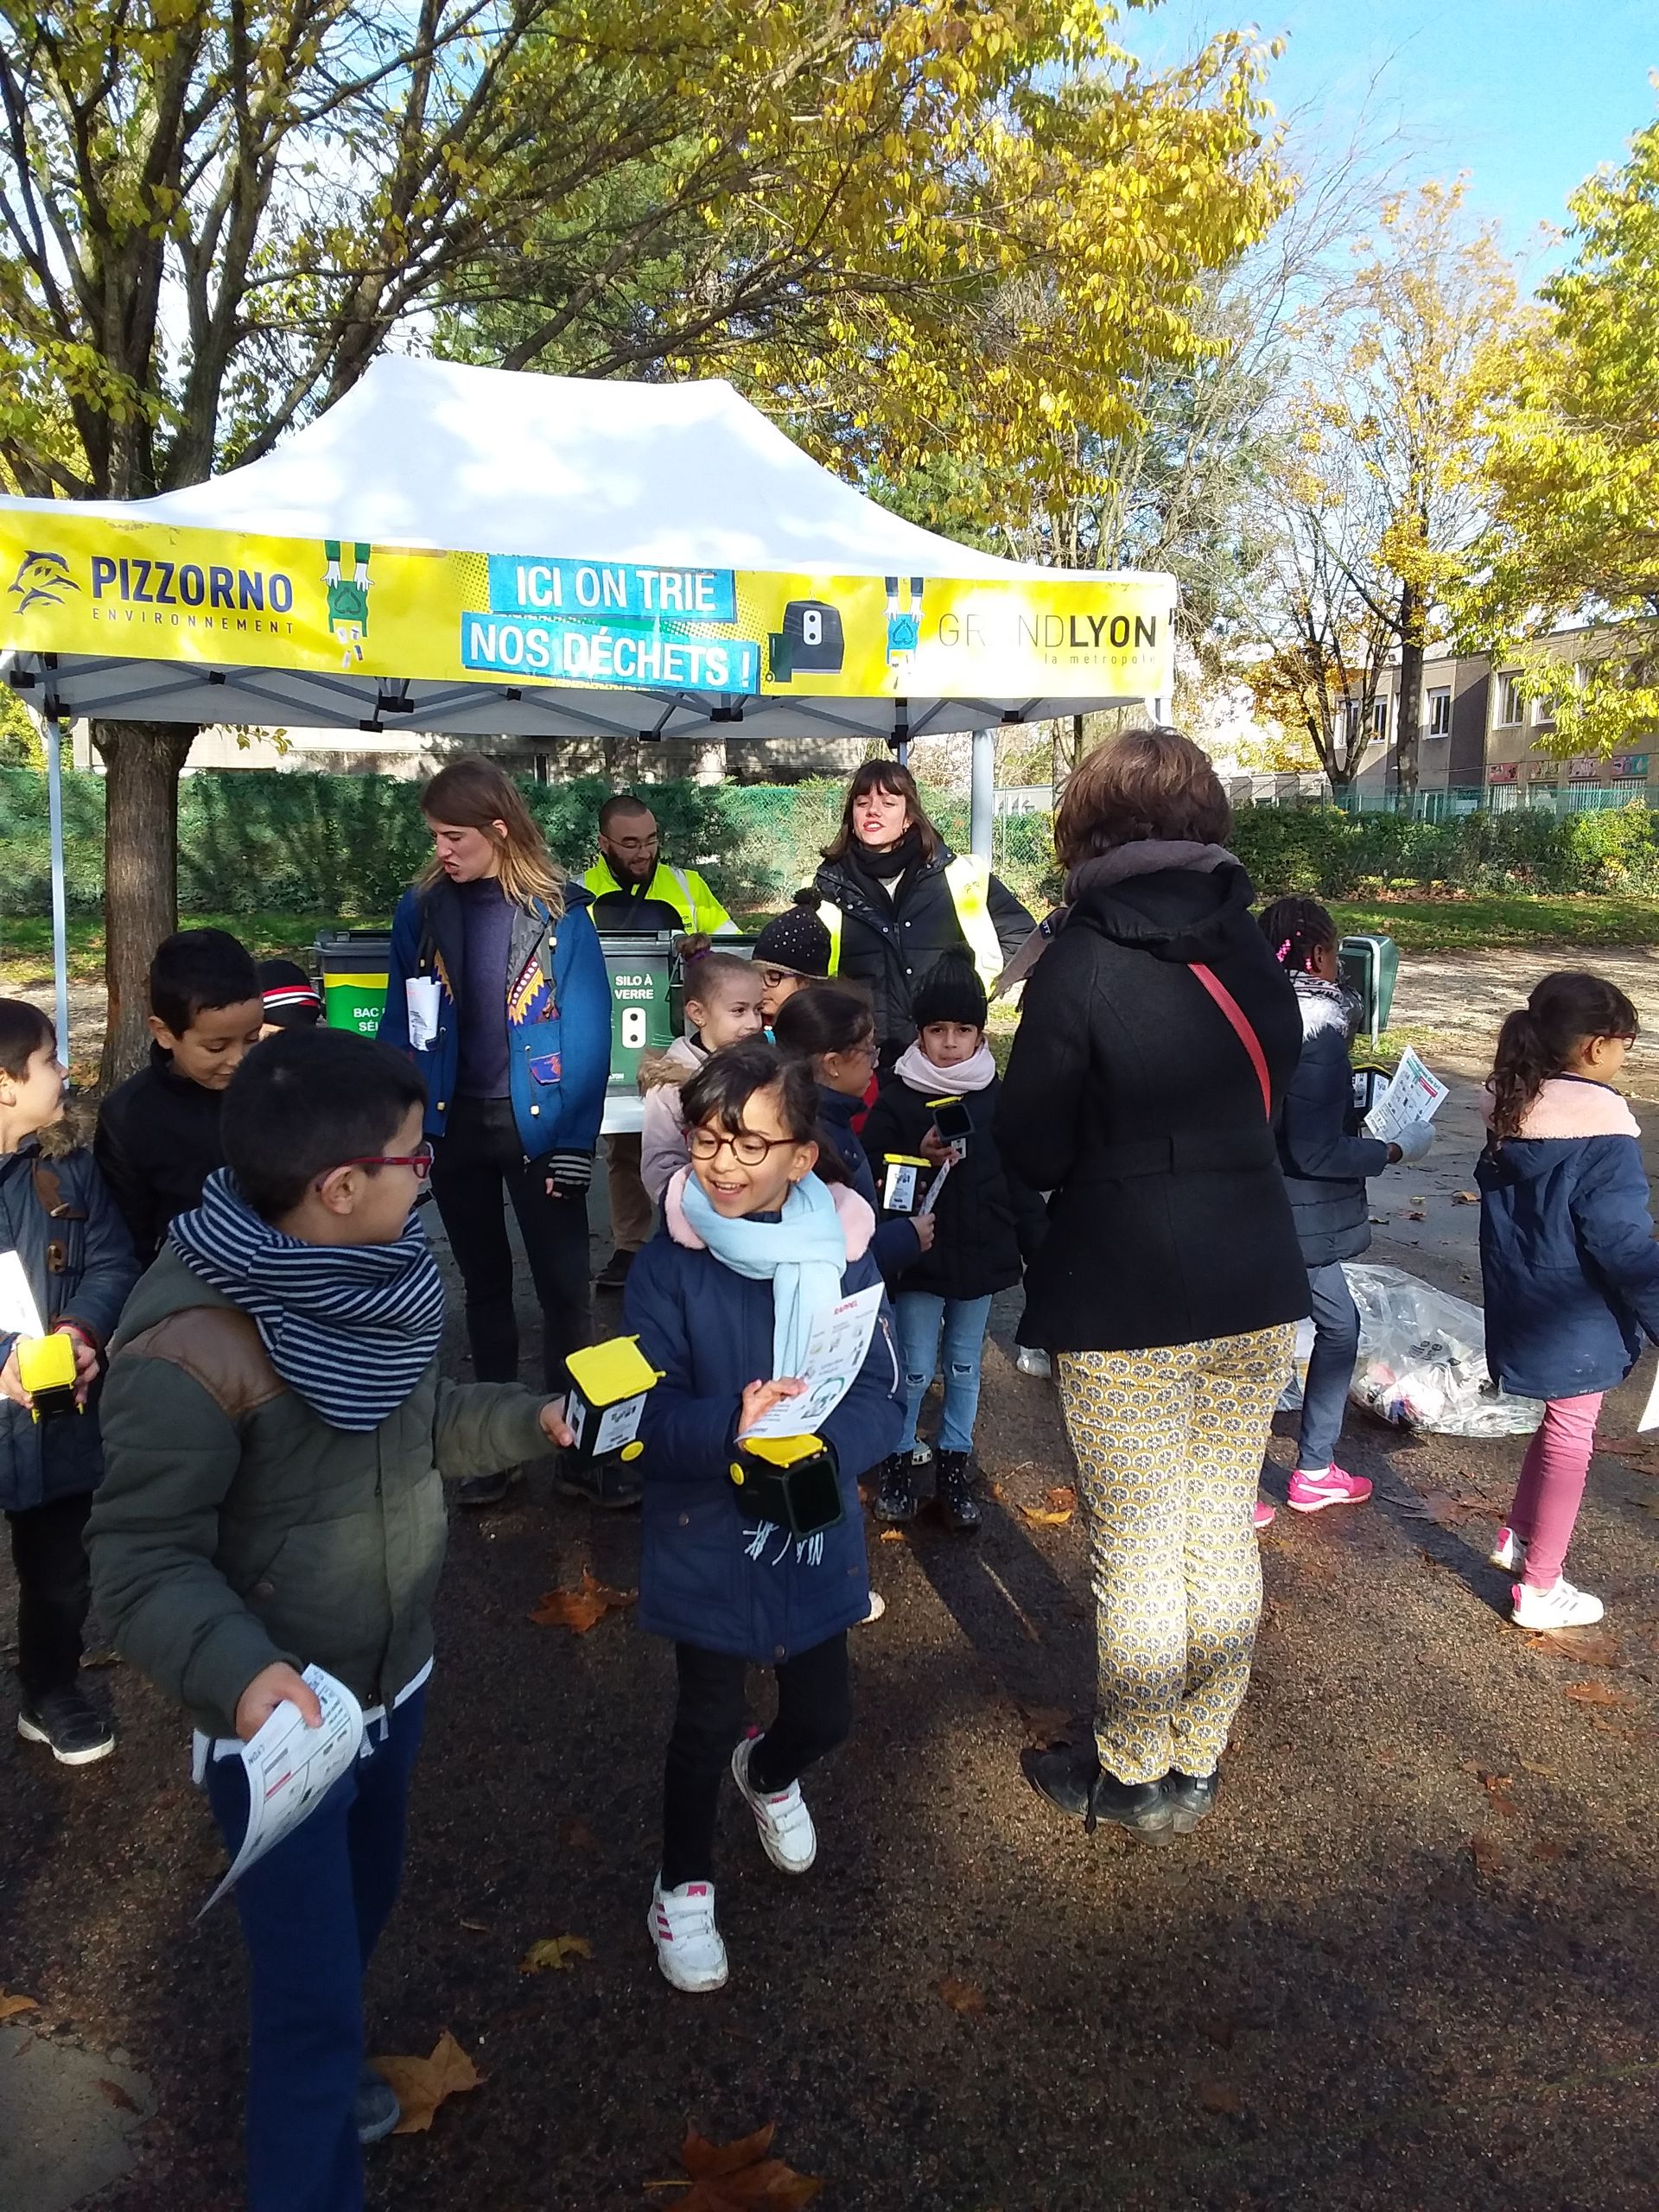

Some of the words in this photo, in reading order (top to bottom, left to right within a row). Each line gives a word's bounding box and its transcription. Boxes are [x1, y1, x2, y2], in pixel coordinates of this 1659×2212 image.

[91, 555, 293, 613] PIZZORNO
[516, 565, 563, 607] ICI
[575, 567, 627, 609] ON
[636, 569, 717, 612] TRIE
[92, 607, 293, 634] ENVIRONNEMENT
[938, 613, 1156, 648] GRNDLYON
[470, 621, 550, 668] NOS
[562, 626, 729, 687] DÉCHETS
[741, 650, 750, 688] !
[1045, 652, 1058, 664] la
[1070, 652, 1155, 666] métropole
[615, 975, 643, 986] SILO
[644, 973, 653, 986] À
[614, 988, 654, 1000] VERRE
[353, 1007, 379, 1018] BAC
